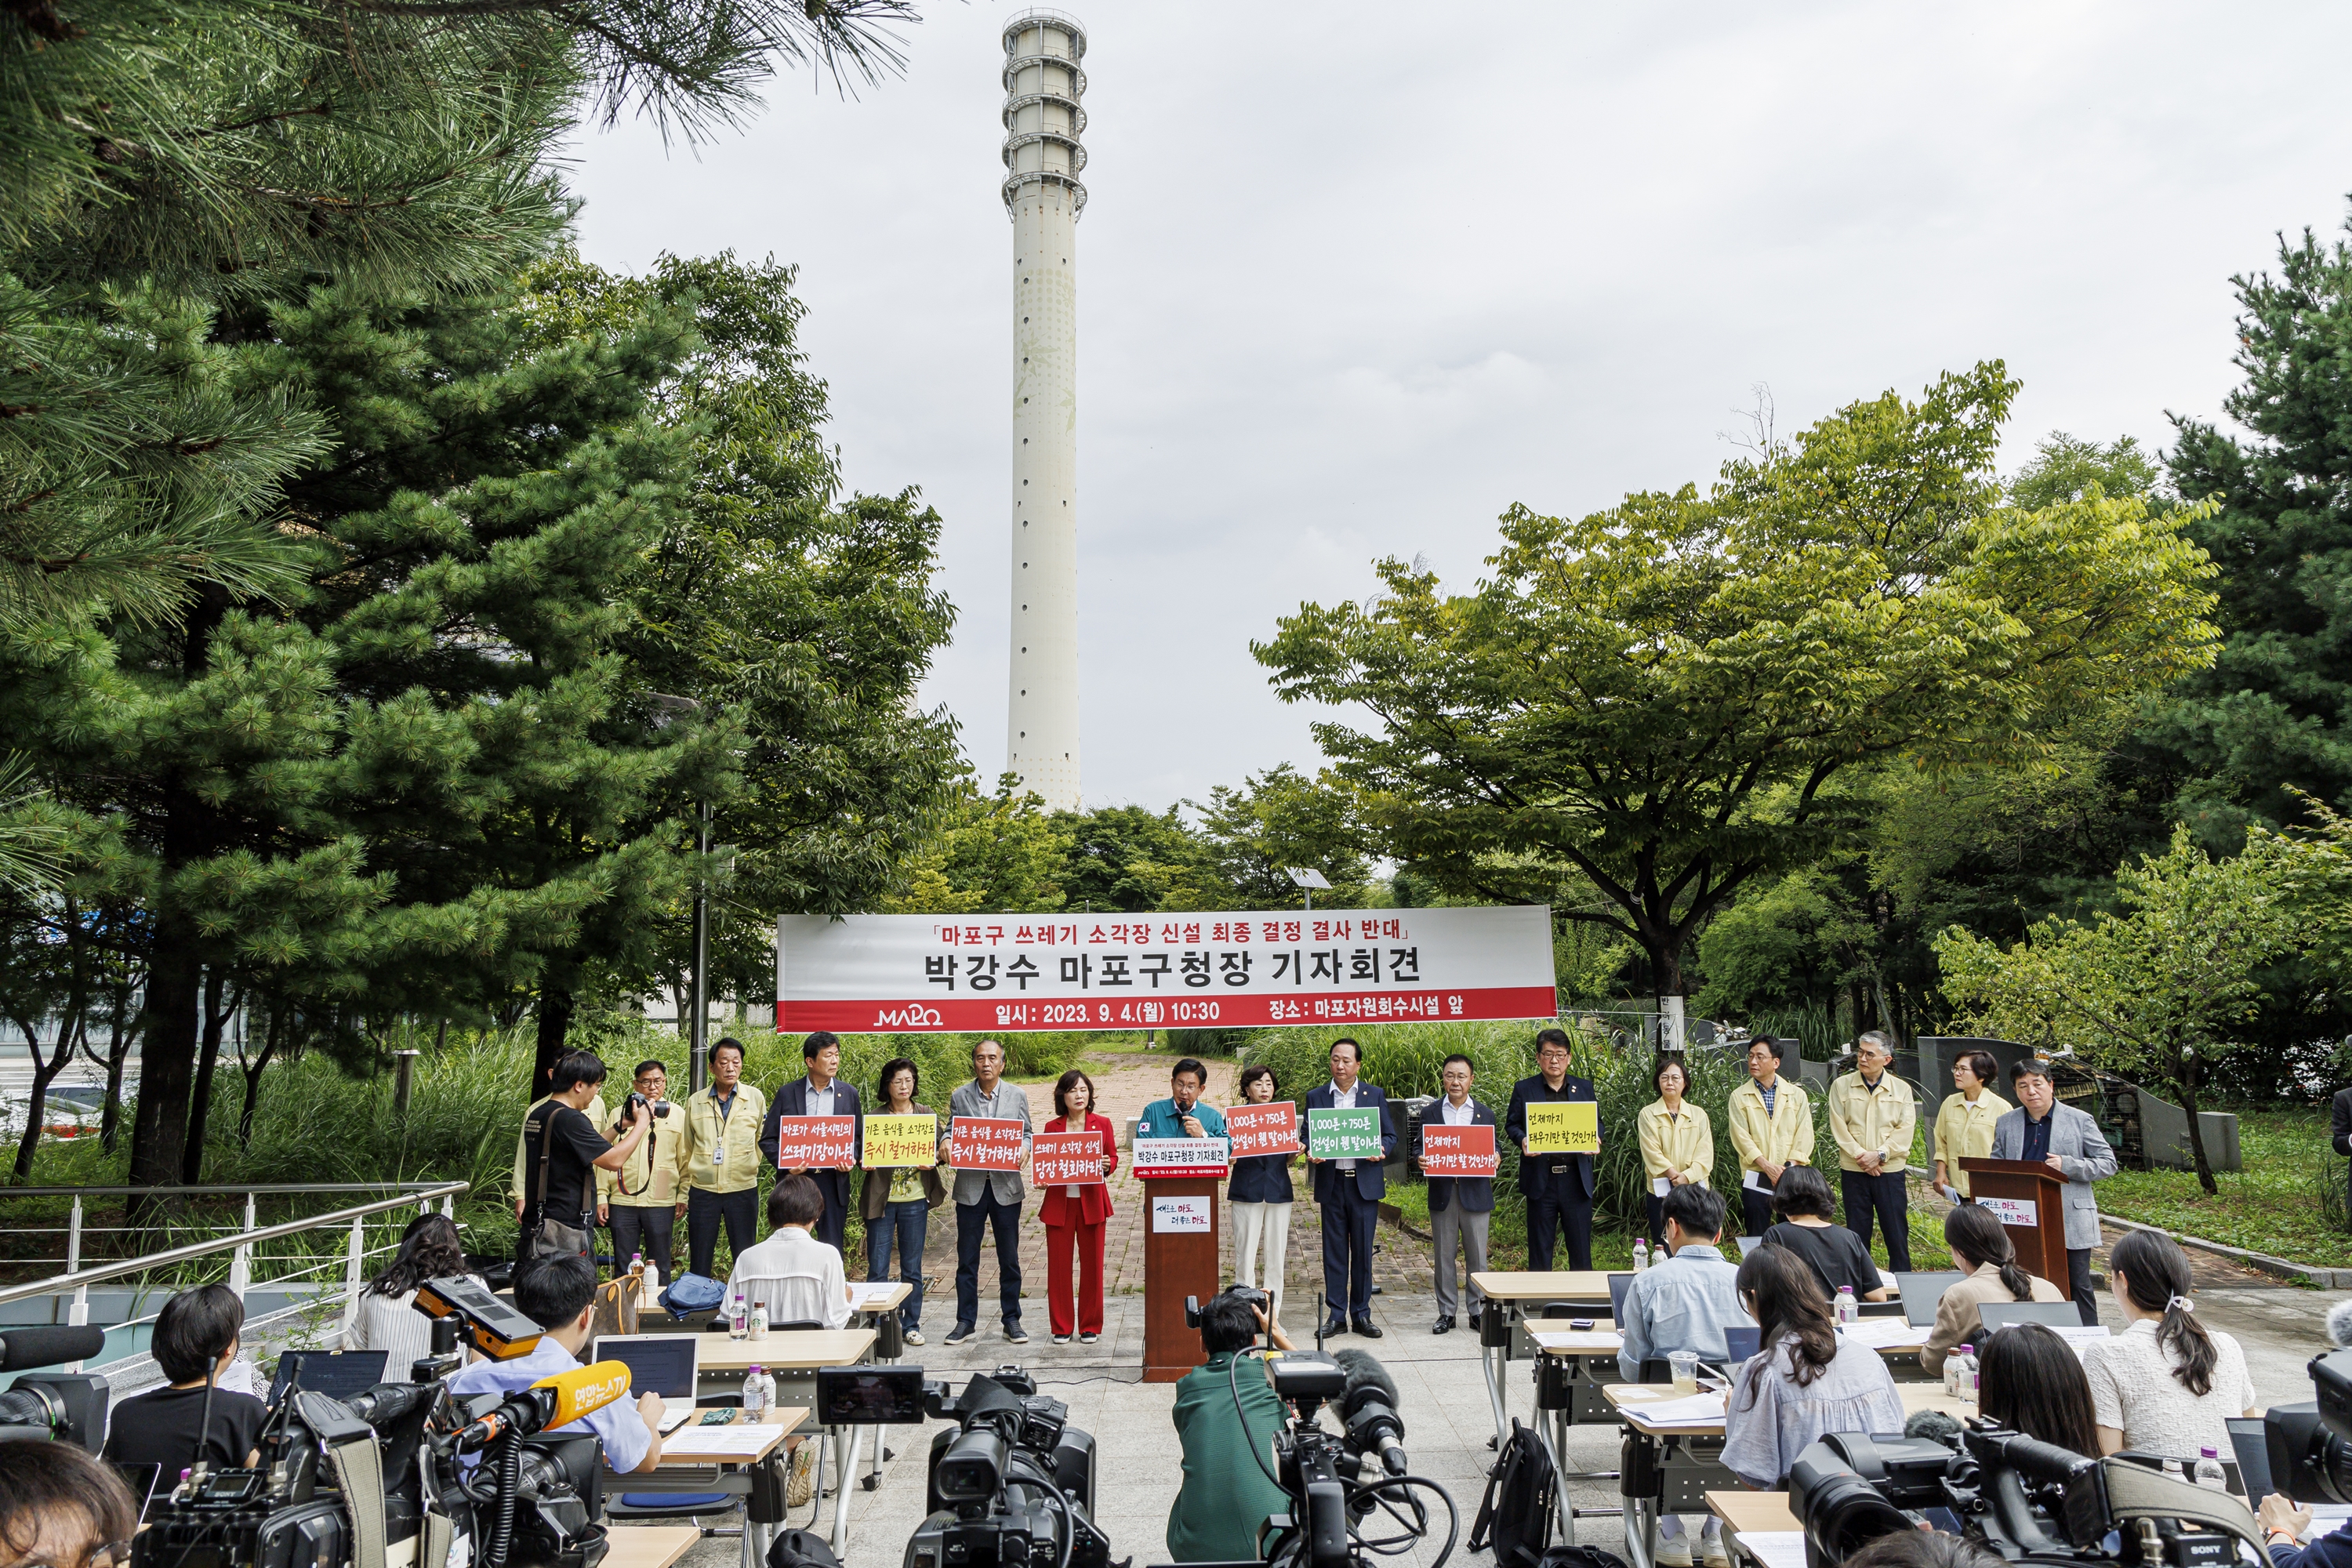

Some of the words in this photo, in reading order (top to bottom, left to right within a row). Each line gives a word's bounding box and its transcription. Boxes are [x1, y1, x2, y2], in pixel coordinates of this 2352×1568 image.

[1015, 924, 1077, 946] 쓰레기
[1088, 924, 1151, 945] 소각장
[1160, 923, 1200, 943] 신설
[1212, 922, 1251, 942] 최종
[1261, 920, 1301, 942] 결정
[1312, 920, 1352, 941] 결사
[925, 954, 1040, 991] 박강수
[1060, 950, 1253, 989] 마포구청장
[1272, 946, 1420, 985] 기자회견
[1044, 1004, 1091, 1022] 2023.
[1099, 1004, 1114, 1022] 9.
[1120, 1002, 1164, 1023] 4.(월)
[1171, 1001, 1220, 1021] 10:30
[1315, 996, 1440, 1018] 마포자원회수시설
[1447, 995, 1464, 1014] 앞
[1228, 1113, 1258, 1131] 1,000톤
[1265, 1110, 1287, 1126] 750톤
[1310, 1116, 1341, 1132] 1,000톤
[1348, 1116, 1371, 1131] 750톤
[1528, 1112, 1563, 1125] 언제까지
[782, 1123, 808, 1137] 마포가
[811, 1122, 852, 1138] 서울시민의
[866, 1123, 879, 1136] 기존
[882, 1123, 904, 1137] 음식물
[907, 1123, 935, 1135] 소각장도
[953, 1125, 967, 1138] 기존
[971, 1125, 992, 1140] 음식물
[994, 1127, 1022, 1141] 소각장도
[1529, 1131, 1560, 1145] 태우기만
[1034, 1142, 1057, 1155] 쓰레기
[1060, 1140, 1083, 1155] 소각장
[1085, 1139, 1101, 1154] 신설
[1231, 1133, 1256, 1150] 건설이
[1268, 1129, 1298, 1148] 말이냐!
[1312, 1135, 1338, 1152] 건설이
[1351, 1134, 1380, 1152] 말이냐!
[1425, 1134, 1461, 1149] 언제까지
[782, 1142, 853, 1162] 쓰레기장이냐!
[864, 1141, 886, 1160] 즉시
[889, 1140, 935, 1160] 철거하라!
[952, 1142, 974, 1162] 즉시
[975, 1142, 1022, 1164] 철거하라!
[1138, 1150, 1158, 1163] 박강수
[1161, 1150, 1194, 1163] 마포구청장
[1196, 1149, 1224, 1162] 기자회견
[1035, 1160, 1057, 1179] 당장
[1058, 1159, 1102, 1179] 철회하라!
[1178, 1203, 1194, 1213] 마포
[2002, 1201, 2020, 1210] 마포
[1171, 1215, 1178, 1225] 더
[1192, 1215, 1207, 1225] 마포
[2016, 1214, 2034, 1223] 마포
[575, 1375, 626, 1412] 연합뉴스TV
[2190, 1544, 2221, 1555] SONY
